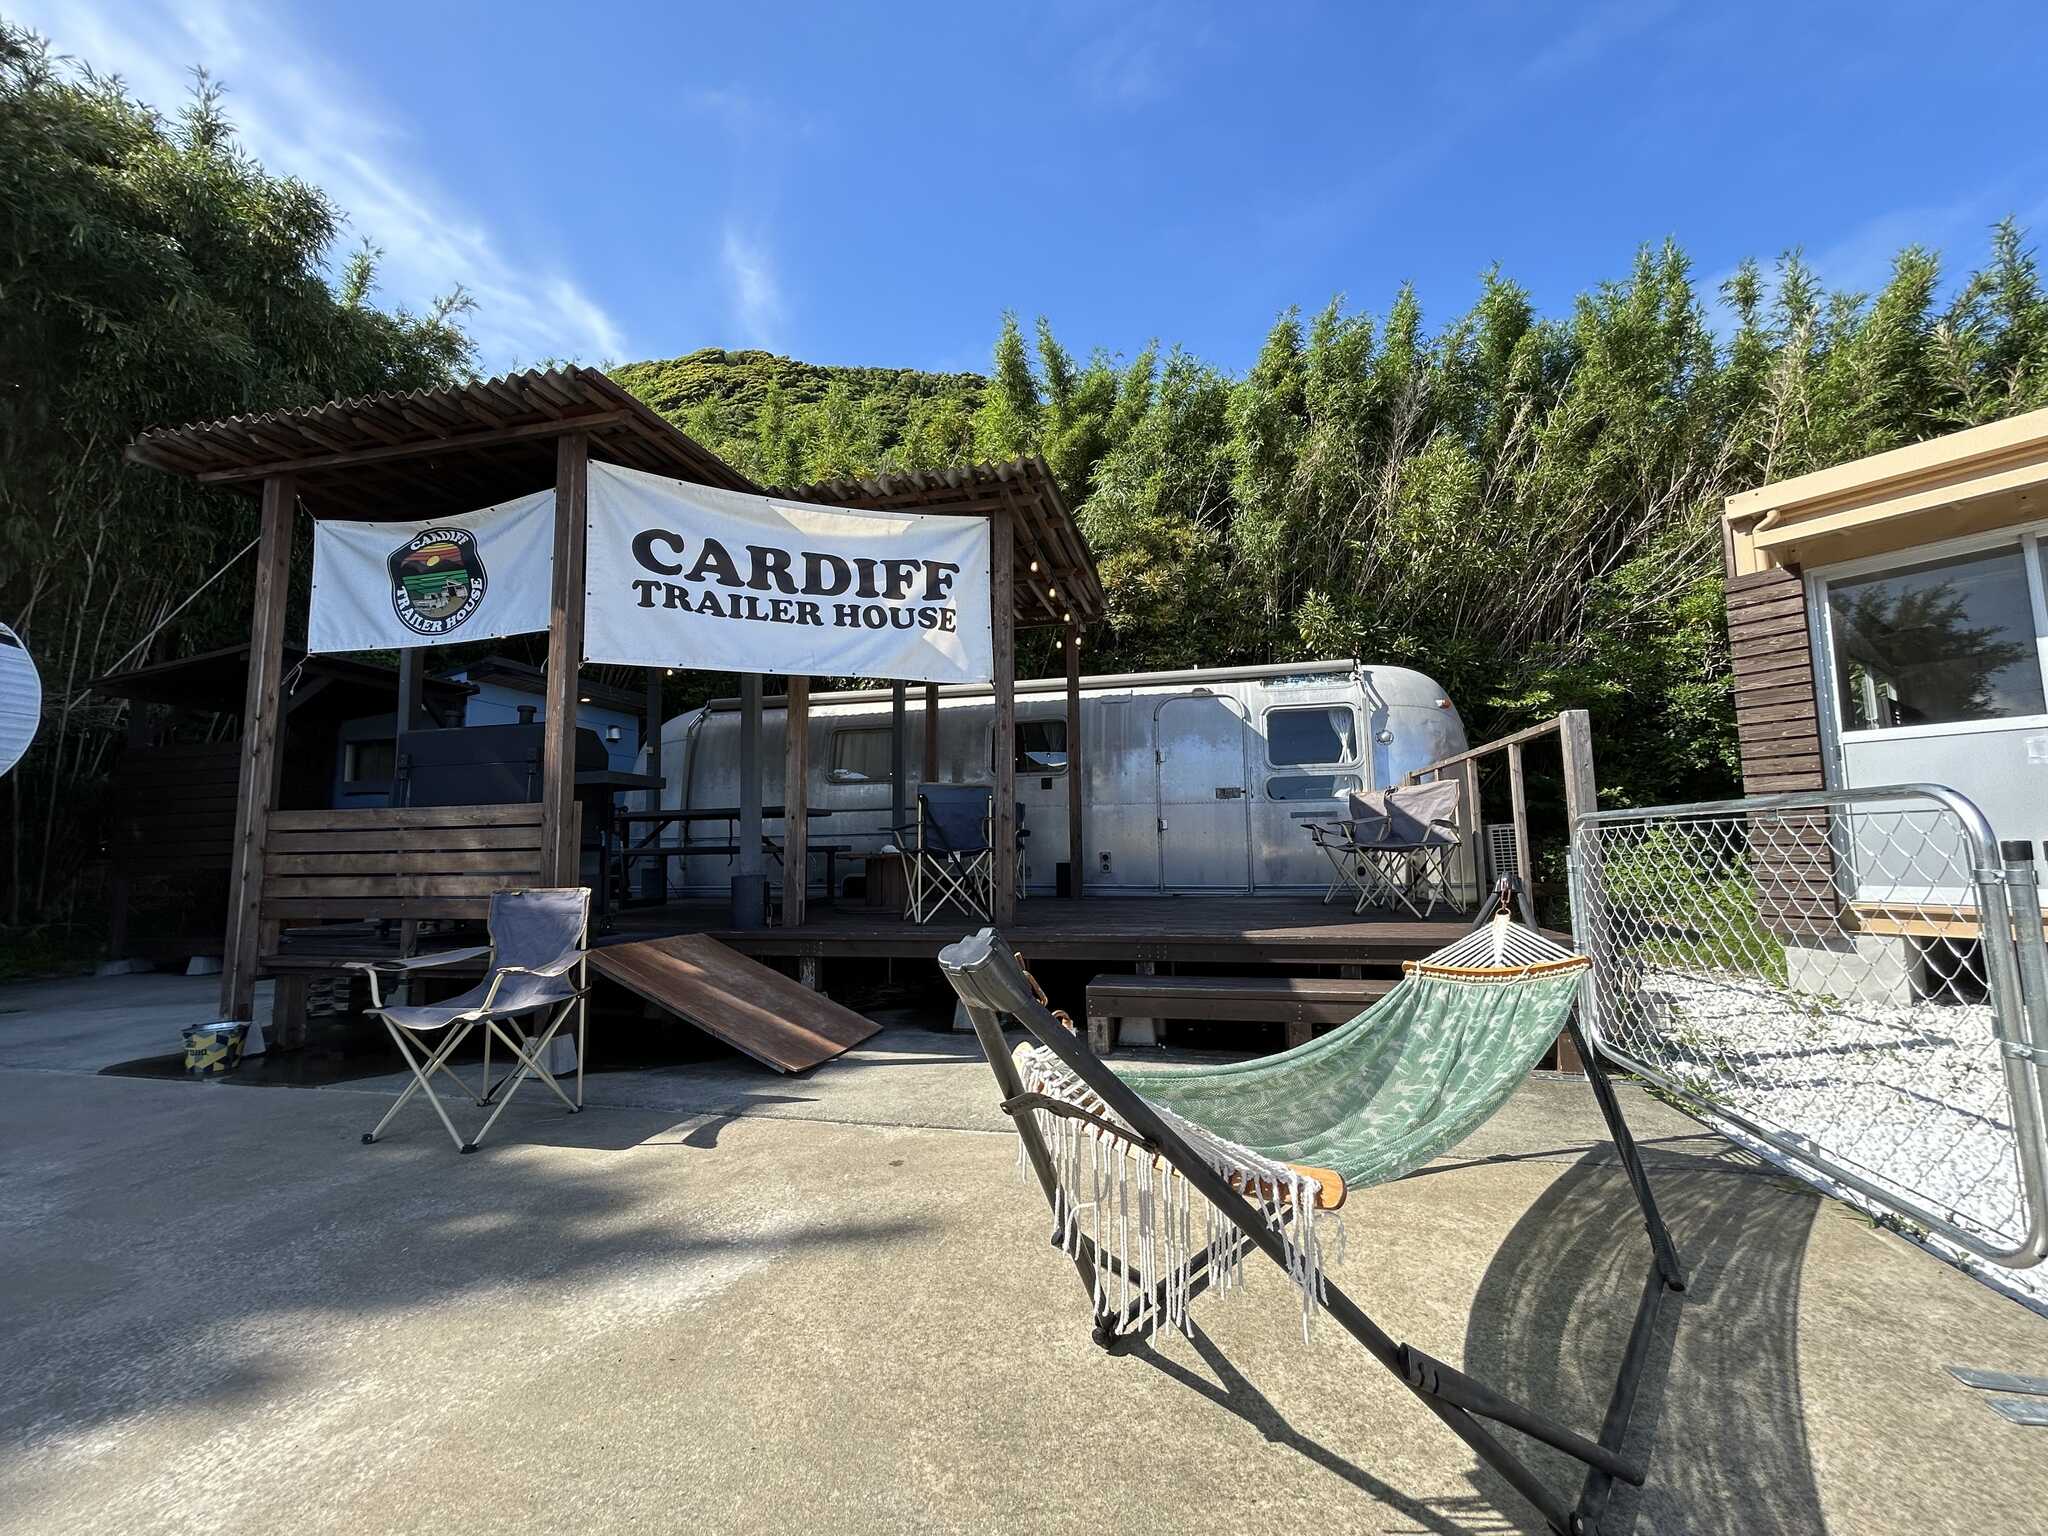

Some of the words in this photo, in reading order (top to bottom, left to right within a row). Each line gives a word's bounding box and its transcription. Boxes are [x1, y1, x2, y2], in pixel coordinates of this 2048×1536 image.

[410, 531, 469, 551] CARDIFF
[631, 528, 960, 601] CARDIFF
[396, 586, 442, 631] TRAILER
[446, 578, 483, 629] HOUSE
[632, 579, 824, 627] TRAILER
[833, 603, 957, 633] HOUSE
